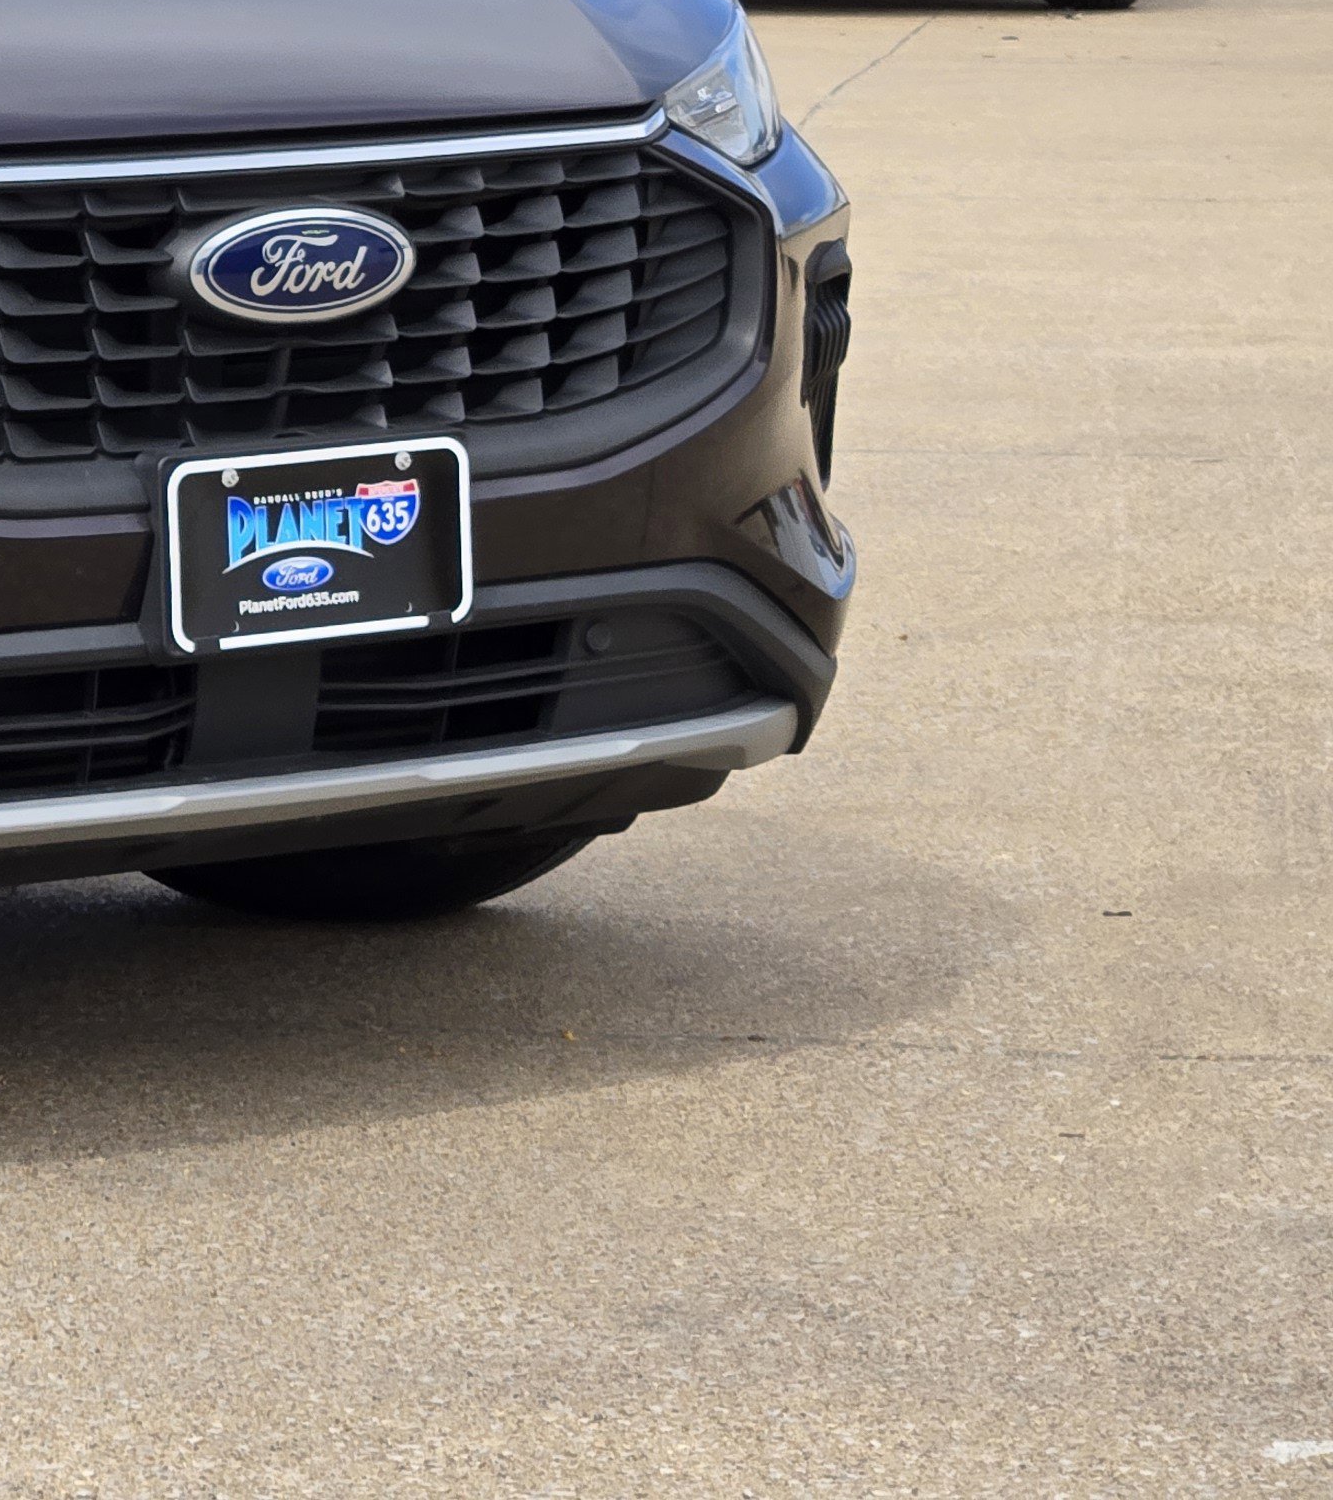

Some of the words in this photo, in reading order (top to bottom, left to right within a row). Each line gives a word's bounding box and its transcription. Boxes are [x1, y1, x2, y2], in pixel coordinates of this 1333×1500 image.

[250, 234, 369, 297] Ford
[227, 495, 366, 567] PLANET
[366, 501, 410, 533] 635
[275, 563, 319, 587] Ford
[239, 590, 360, 616] PlanetFord635.com
